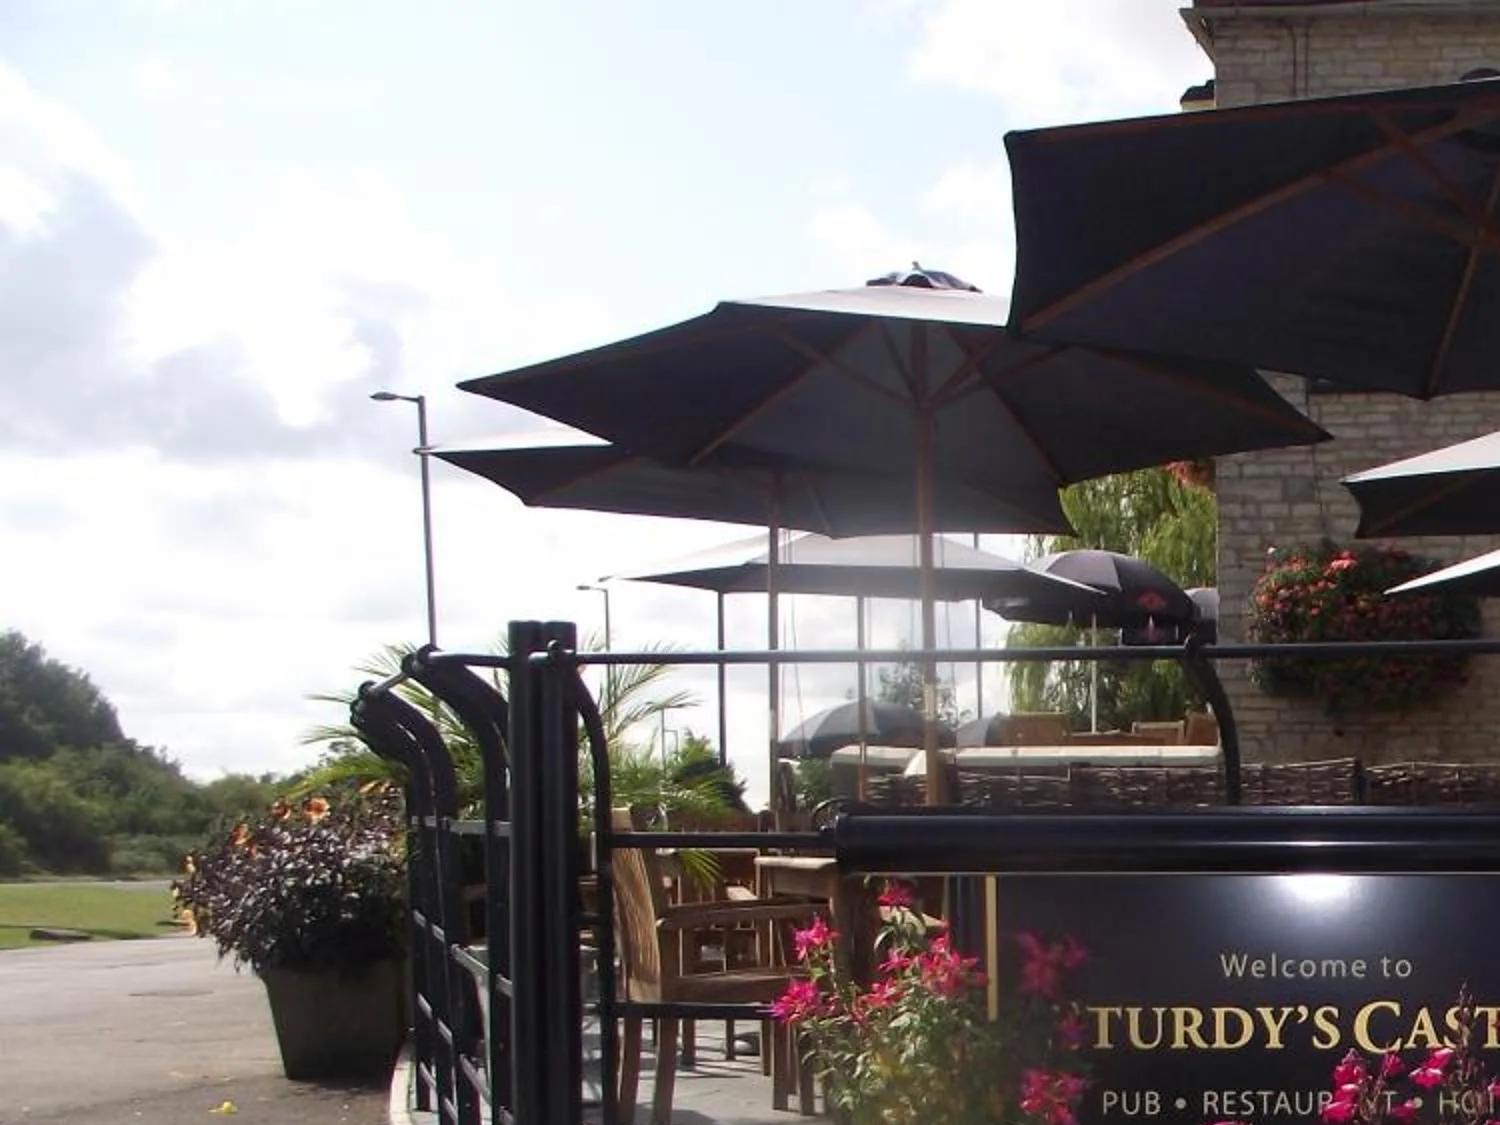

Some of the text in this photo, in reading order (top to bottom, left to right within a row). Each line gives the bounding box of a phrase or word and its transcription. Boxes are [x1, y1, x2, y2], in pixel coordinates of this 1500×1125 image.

[1219, 951, 1413, 978] Welcome to
[1052, 1002, 1342, 1052] TURDY'S
[1102, 1090, 1162, 1116] PUB
